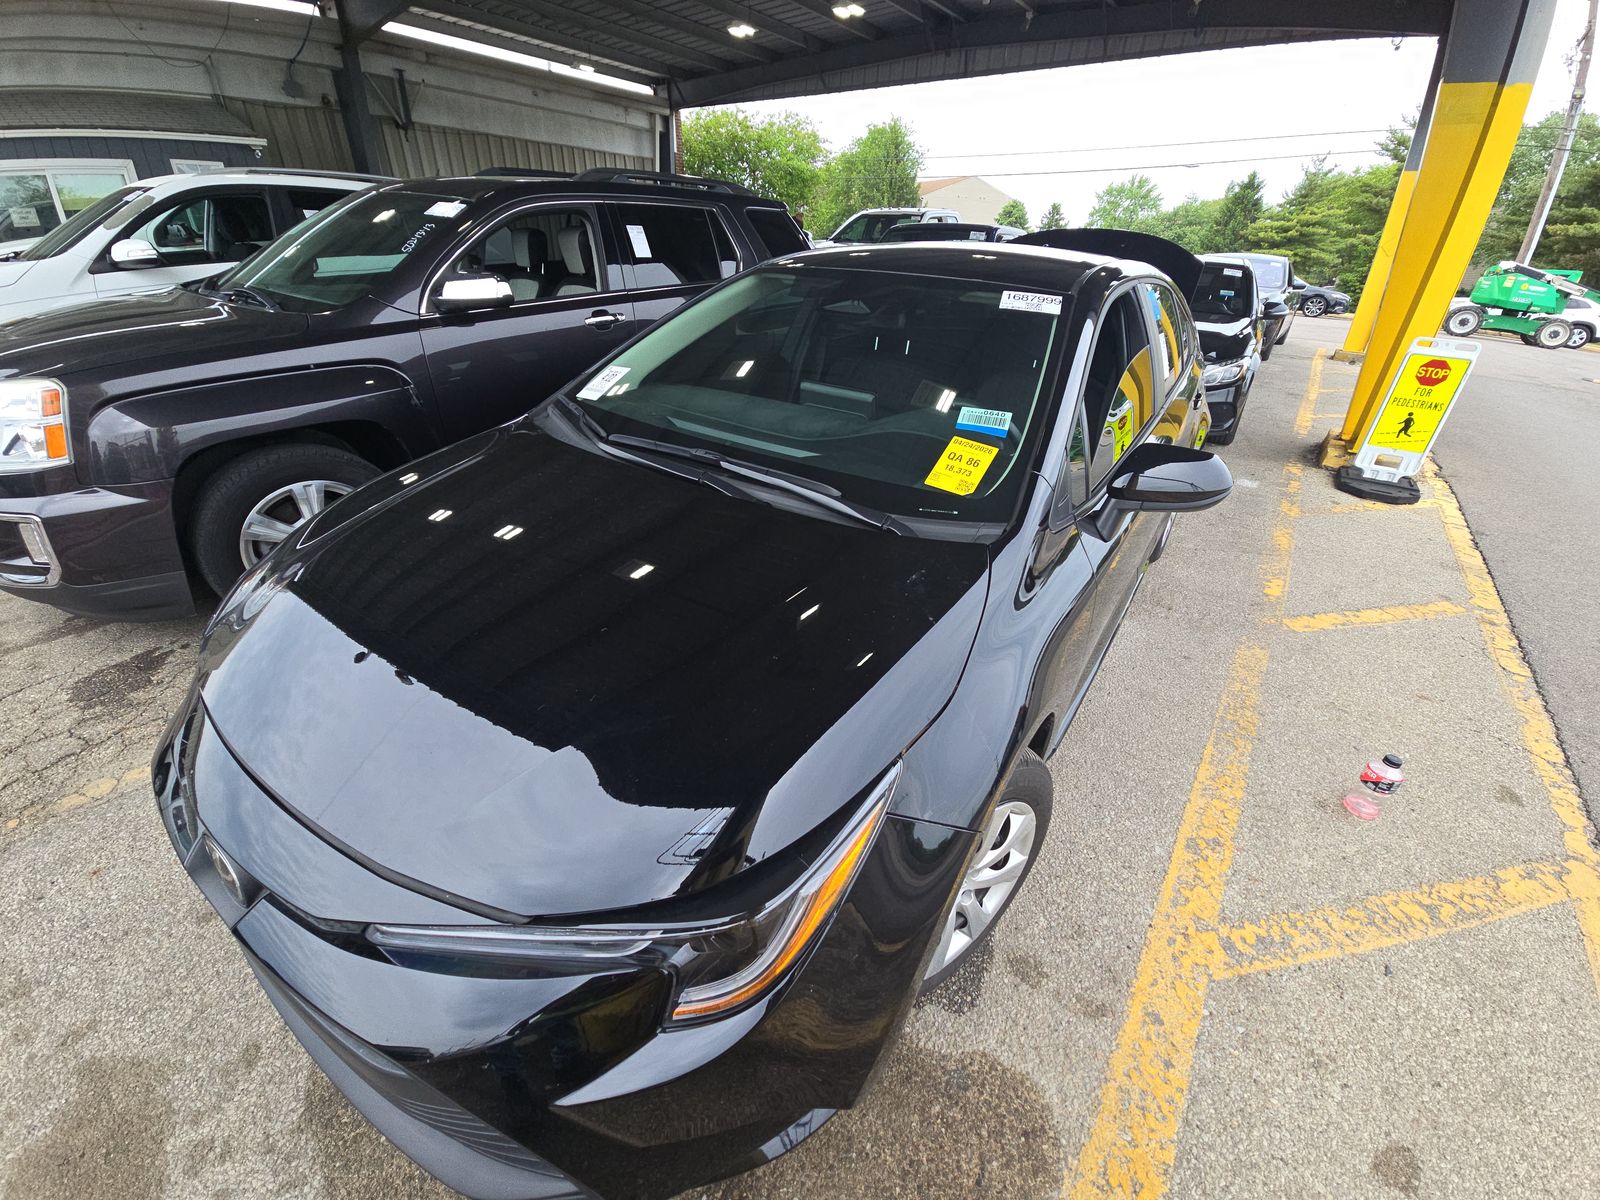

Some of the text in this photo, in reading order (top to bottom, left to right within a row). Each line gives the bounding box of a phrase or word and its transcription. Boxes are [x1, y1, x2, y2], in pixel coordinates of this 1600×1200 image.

[1007, 293, 1062, 305] 1687999
[1417, 367, 1450, 379] STOP
[1414, 387, 1433, 397] FOR
[1391, 397, 1444, 412] PEDESTRIANS
[953, 439, 993, 455] 04/24/2026
[947, 451, 981, 468] QA 86
